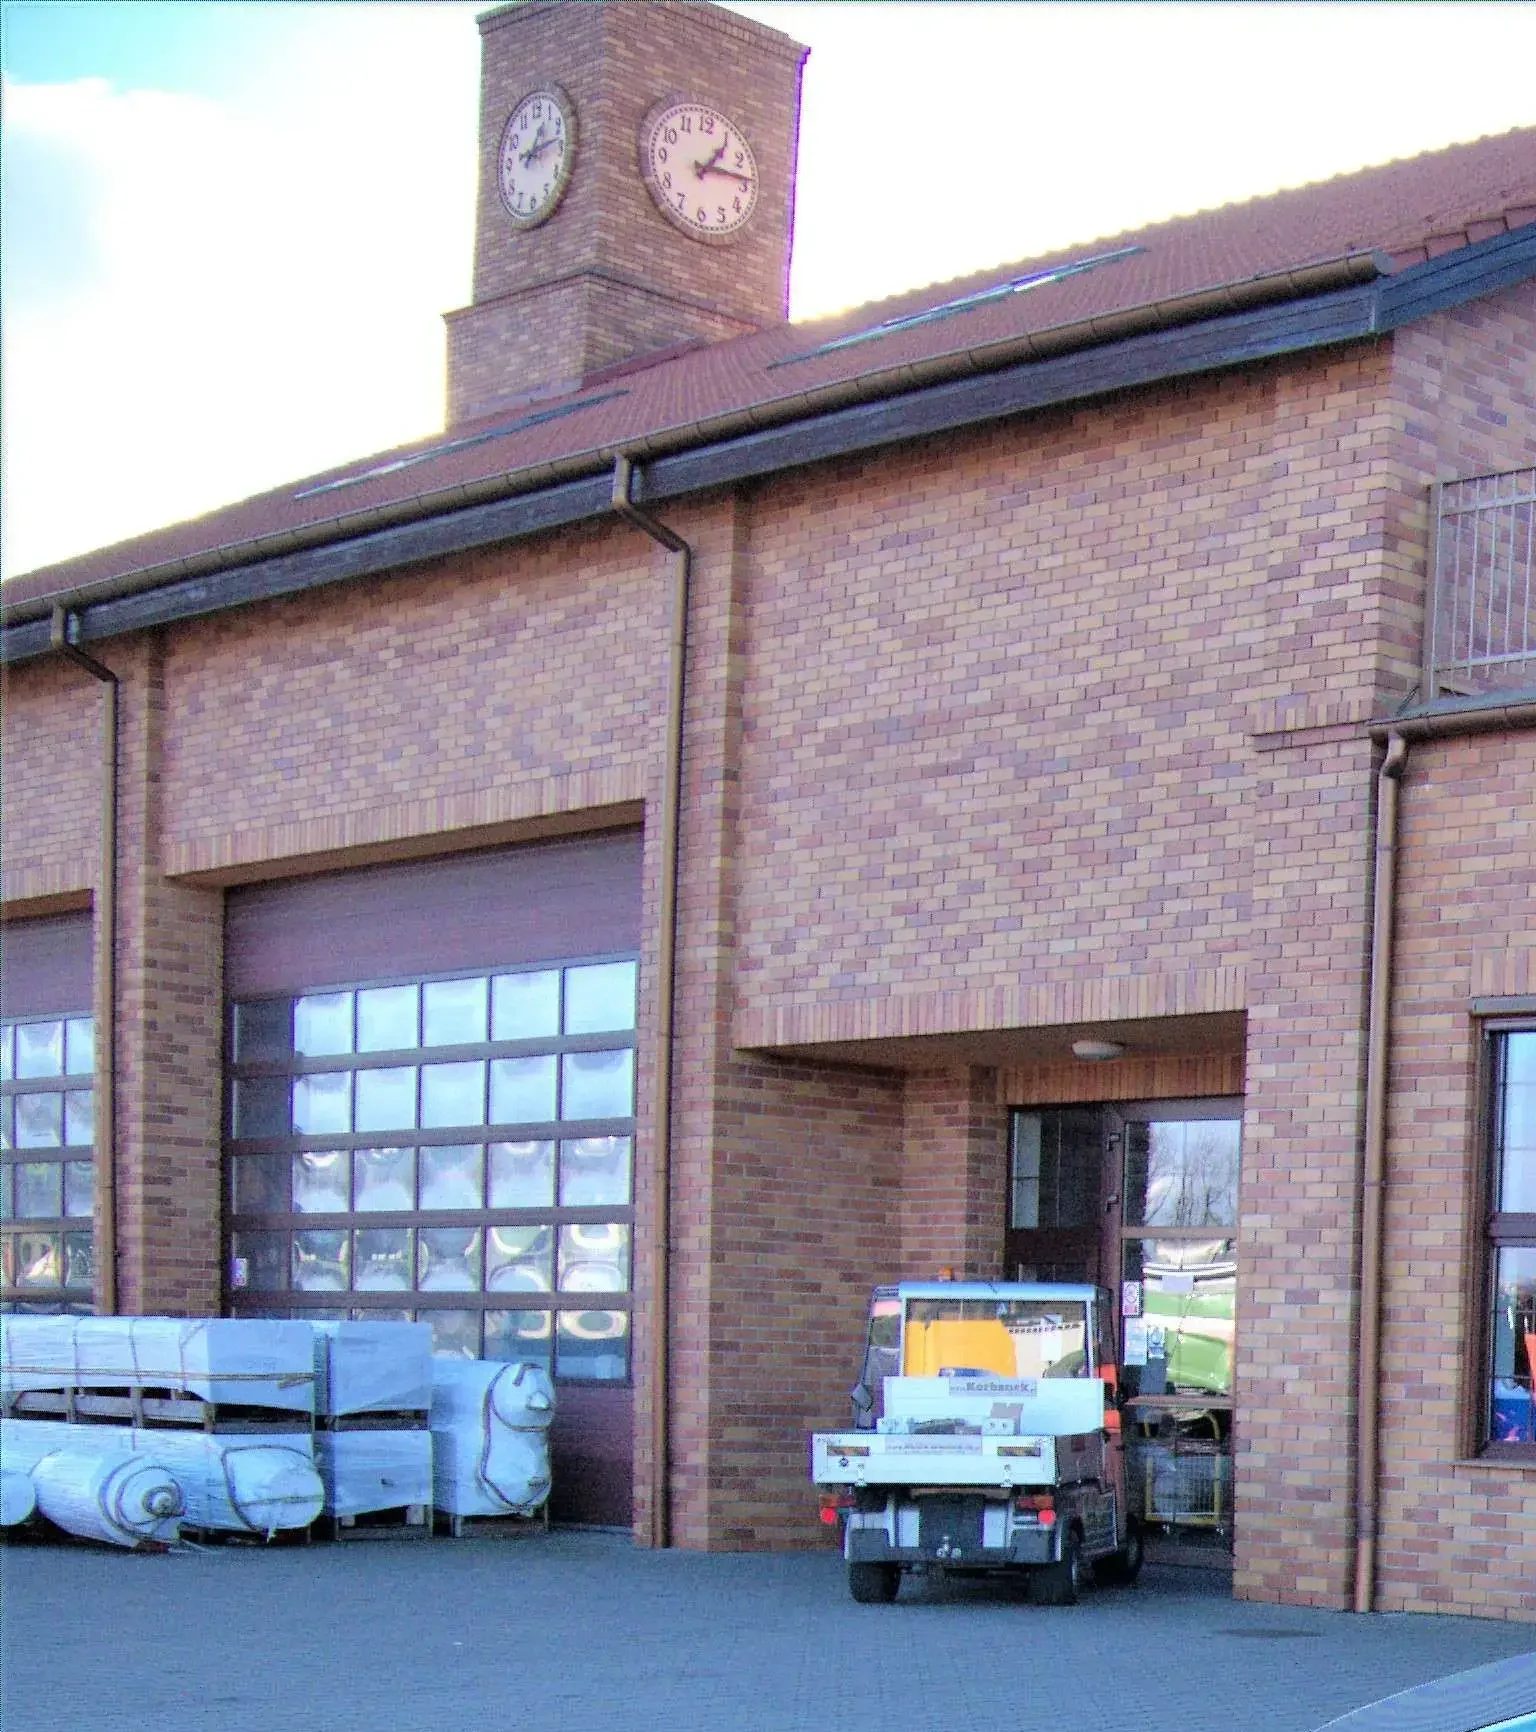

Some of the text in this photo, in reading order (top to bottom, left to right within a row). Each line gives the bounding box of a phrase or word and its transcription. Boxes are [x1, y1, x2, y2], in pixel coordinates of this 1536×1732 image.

[681, 115, 692, 134] 11
[699, 115, 714, 135] 12
[664, 126, 677, 144] 10
